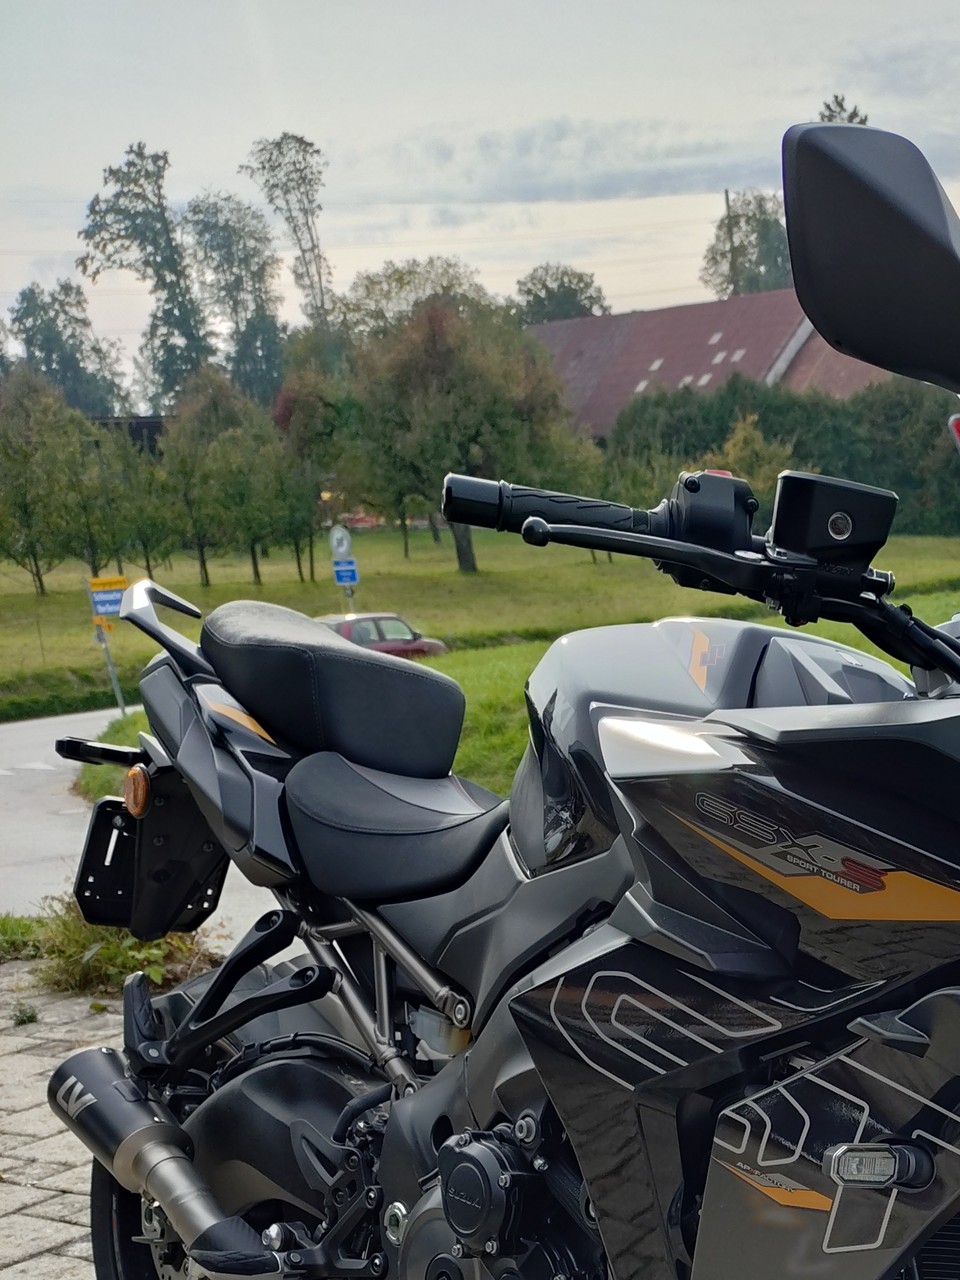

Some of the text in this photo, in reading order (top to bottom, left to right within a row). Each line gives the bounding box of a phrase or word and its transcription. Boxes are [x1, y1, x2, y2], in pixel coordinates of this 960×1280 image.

[694, 791, 888, 891] GSX-S
[786, 854, 861, 892] SPORT TOURER
[56, 1074, 98, 1120] LV
